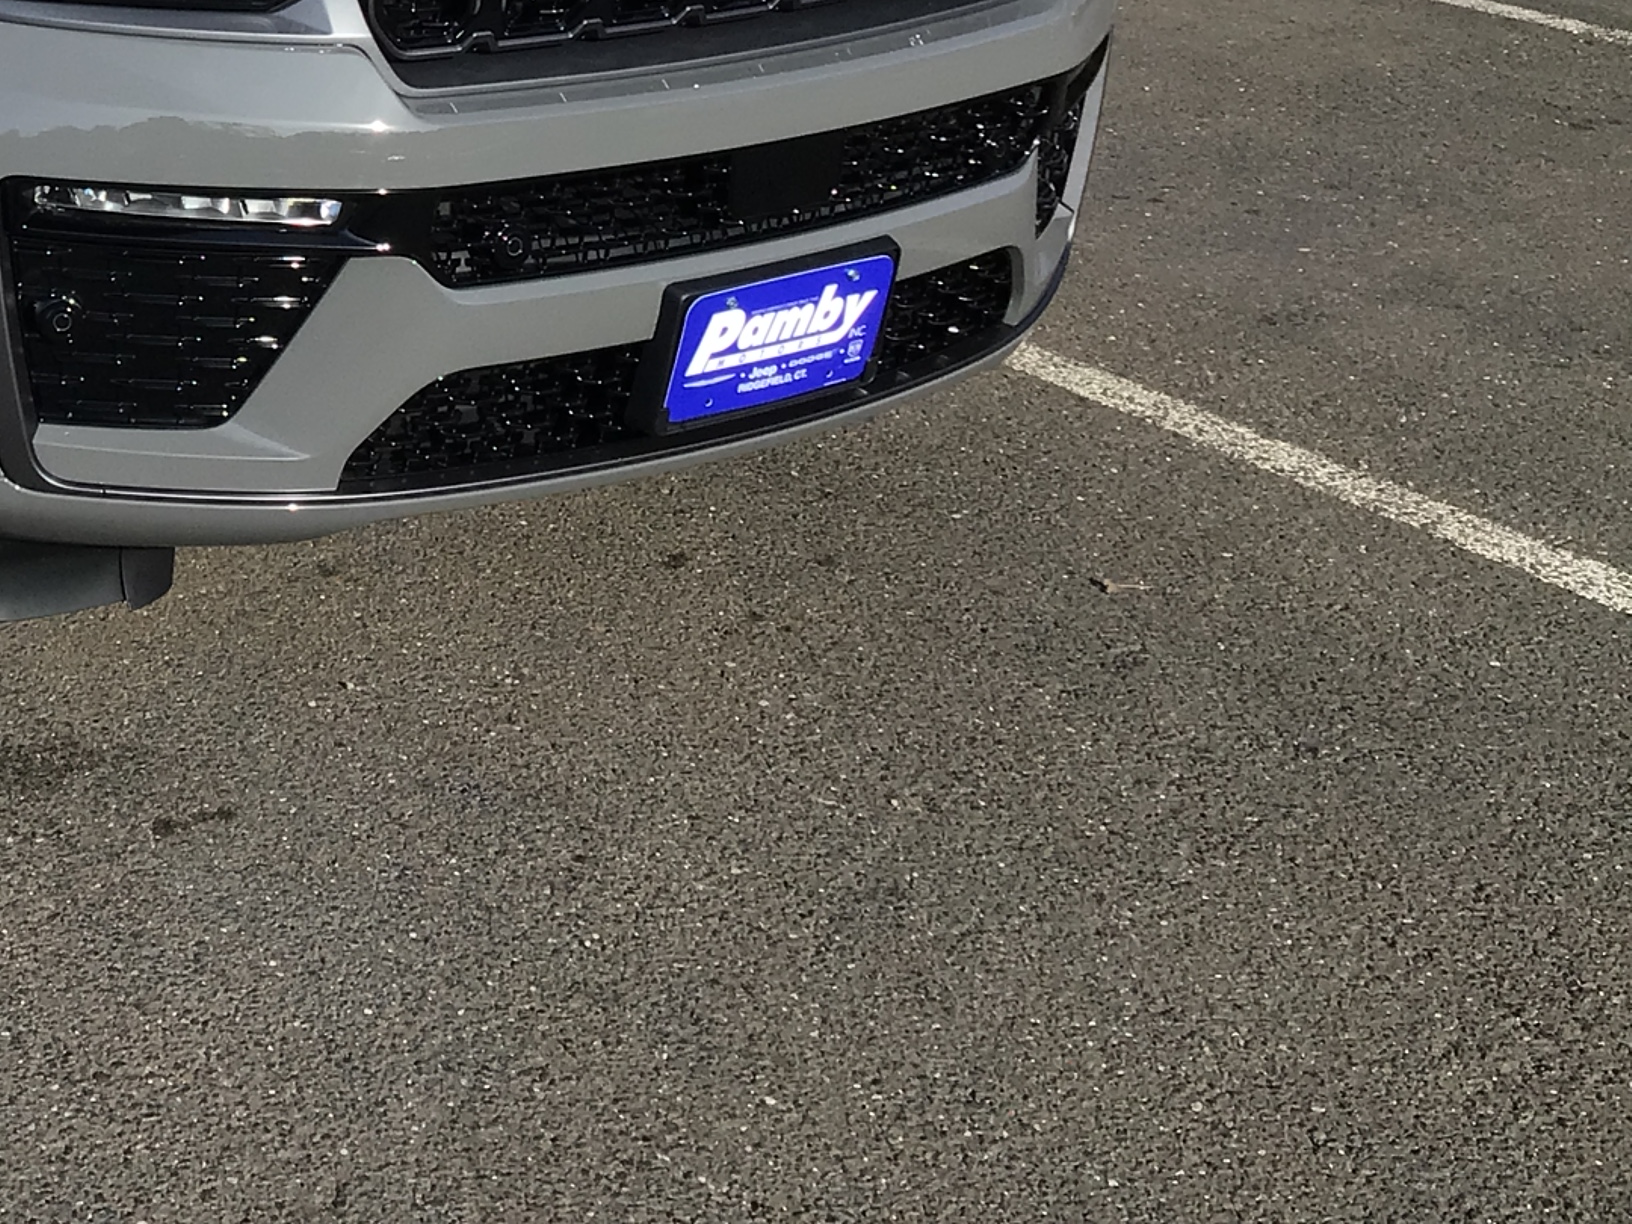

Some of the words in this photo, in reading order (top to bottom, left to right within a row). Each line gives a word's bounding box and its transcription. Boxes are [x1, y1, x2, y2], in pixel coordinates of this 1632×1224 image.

[685, 283, 879, 377] Pamby
[717, 336, 822, 368] MOTORS
[748, 364, 778, 380] Jeep
